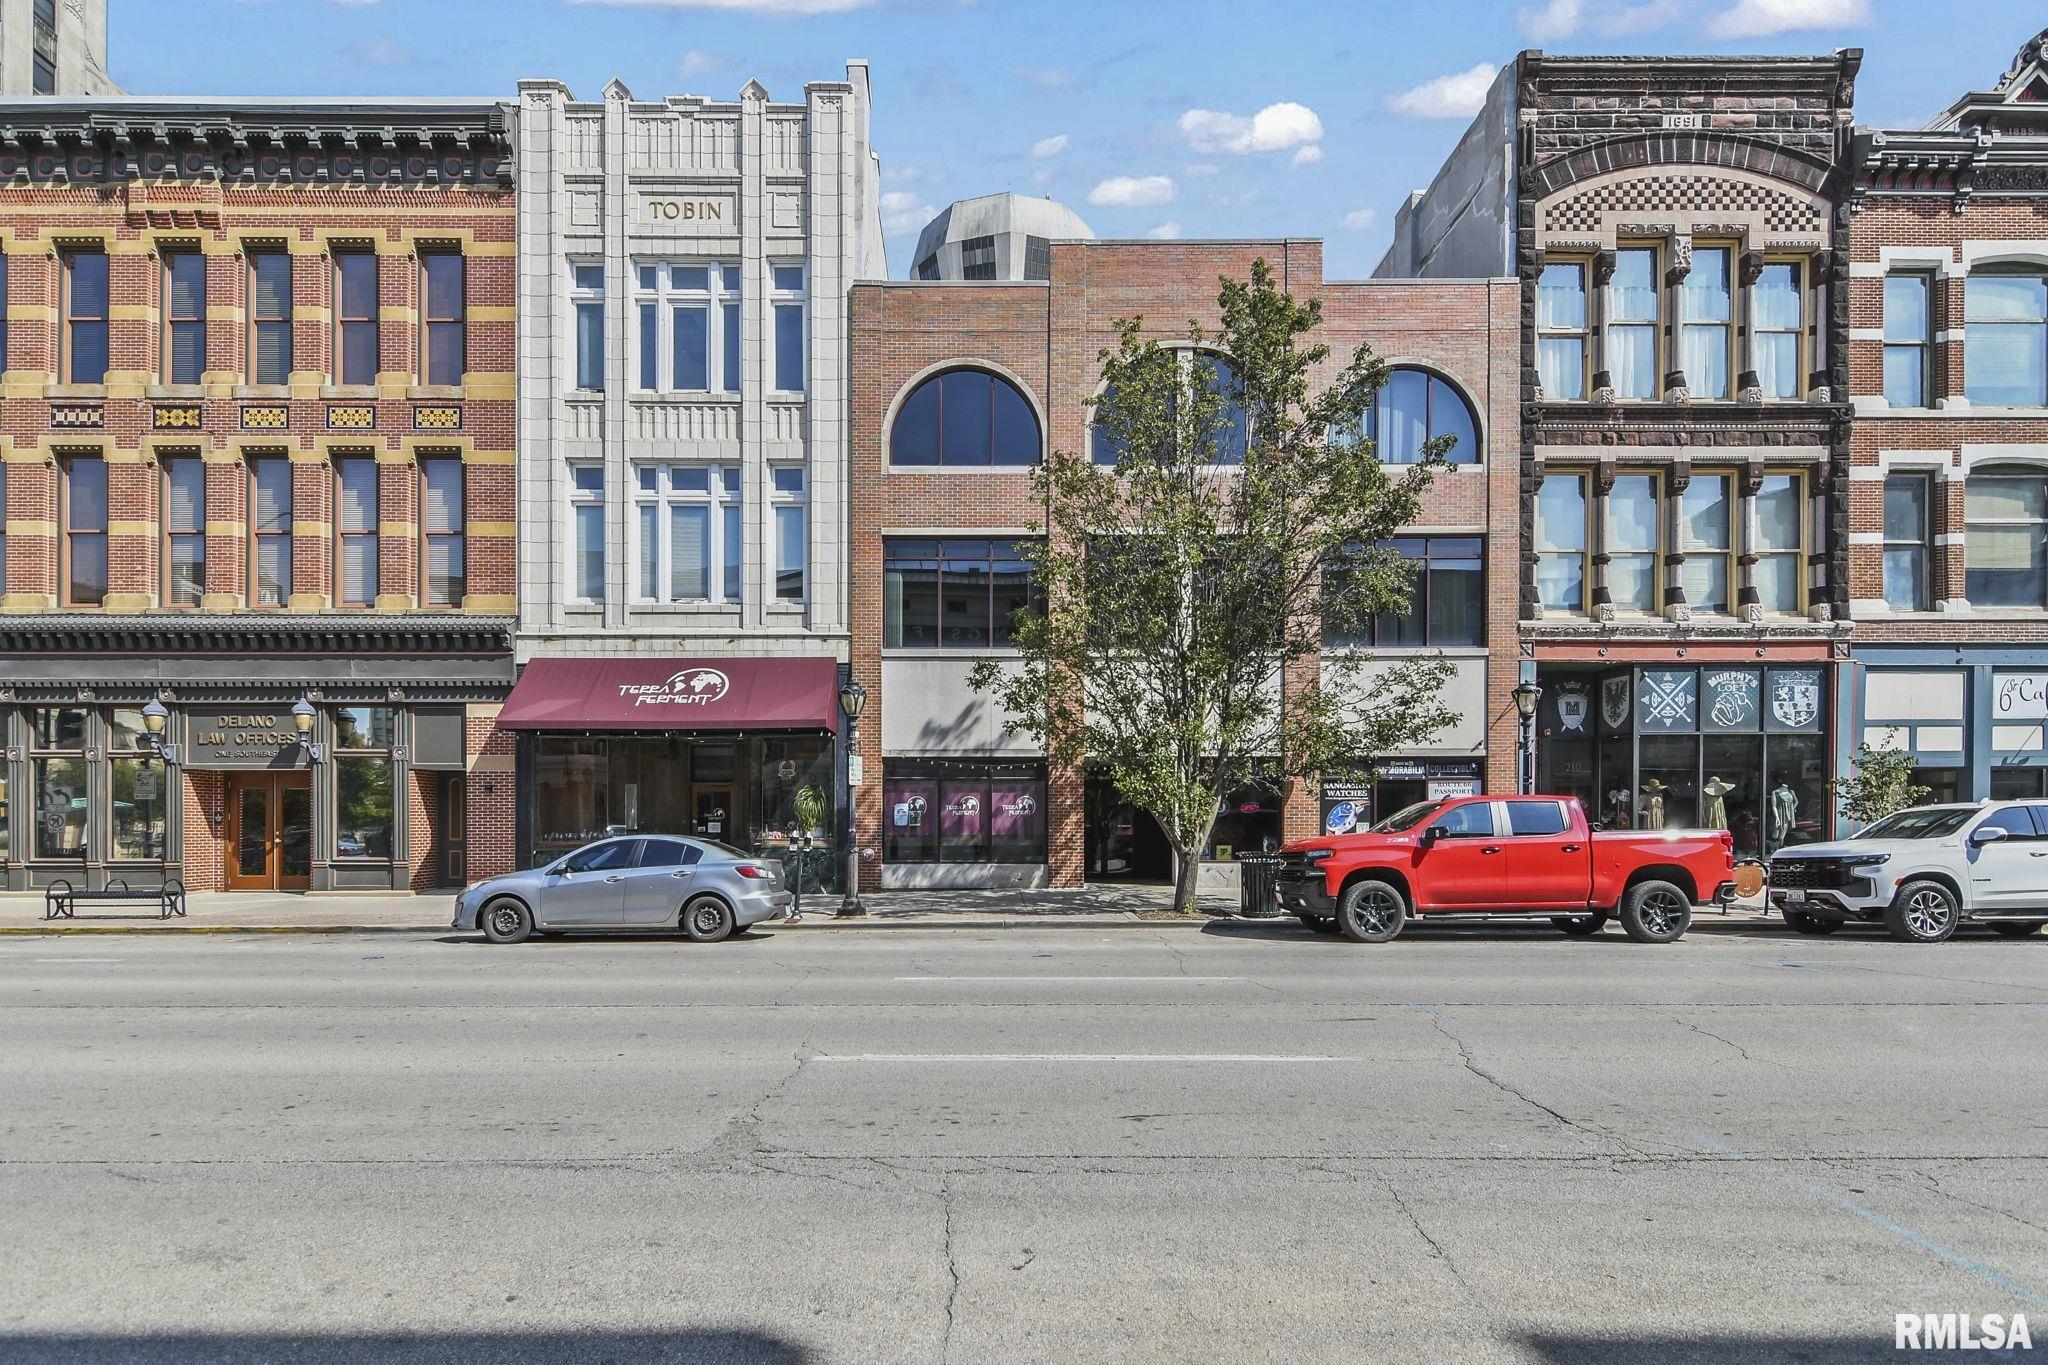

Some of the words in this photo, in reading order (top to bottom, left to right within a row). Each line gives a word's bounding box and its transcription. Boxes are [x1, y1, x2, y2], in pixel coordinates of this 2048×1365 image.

[648, 201, 722, 220] TOBIN
[1707, 671, 1758, 688] MURPHY'S
[618, 685, 670, 696] TERRA
[1717, 684, 1748, 692] LOFT
[634, 694, 712, 707] FERMENT
[218, 715, 277, 728] DELANO
[197, 732, 228, 745] LAW
[234, 731, 297, 745] OFFICES
[214, 750, 232, 758] ONE
